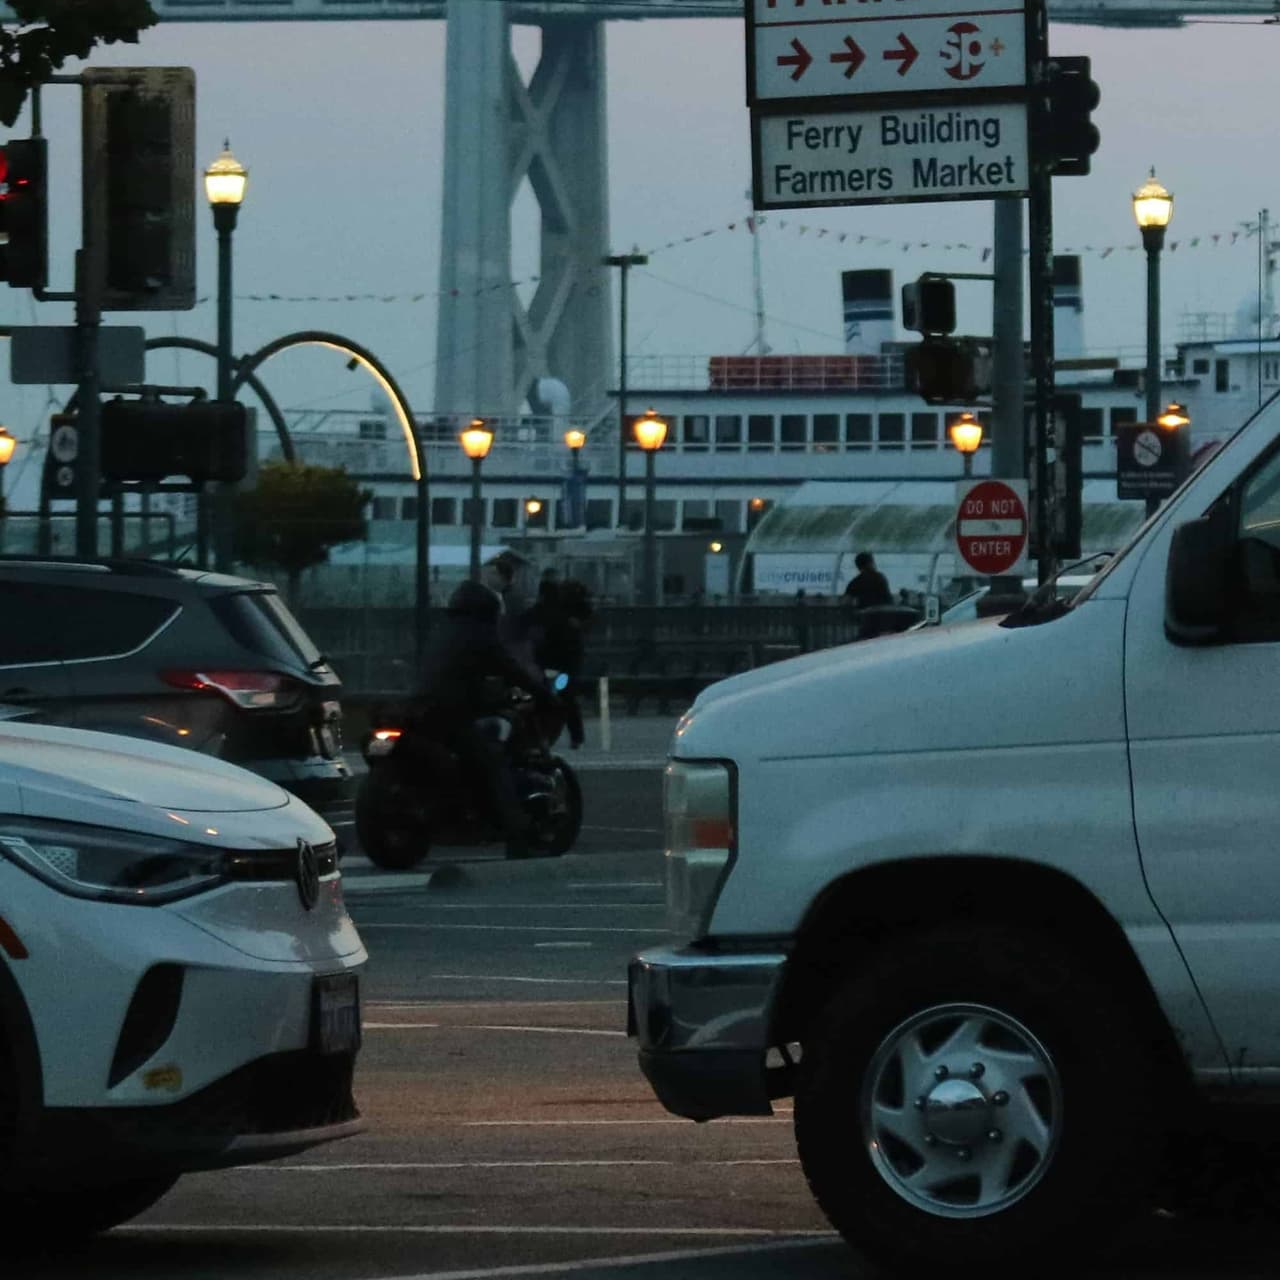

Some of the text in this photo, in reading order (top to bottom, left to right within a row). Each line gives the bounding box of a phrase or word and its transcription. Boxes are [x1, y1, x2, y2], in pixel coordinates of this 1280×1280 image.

[787, 114, 1001, 153] Ferry Building
[775, 155, 1015, 195] Farmers Market
[967, 499, 1017, 514] DO NOT
[971, 541, 1011, 556] ENTER
